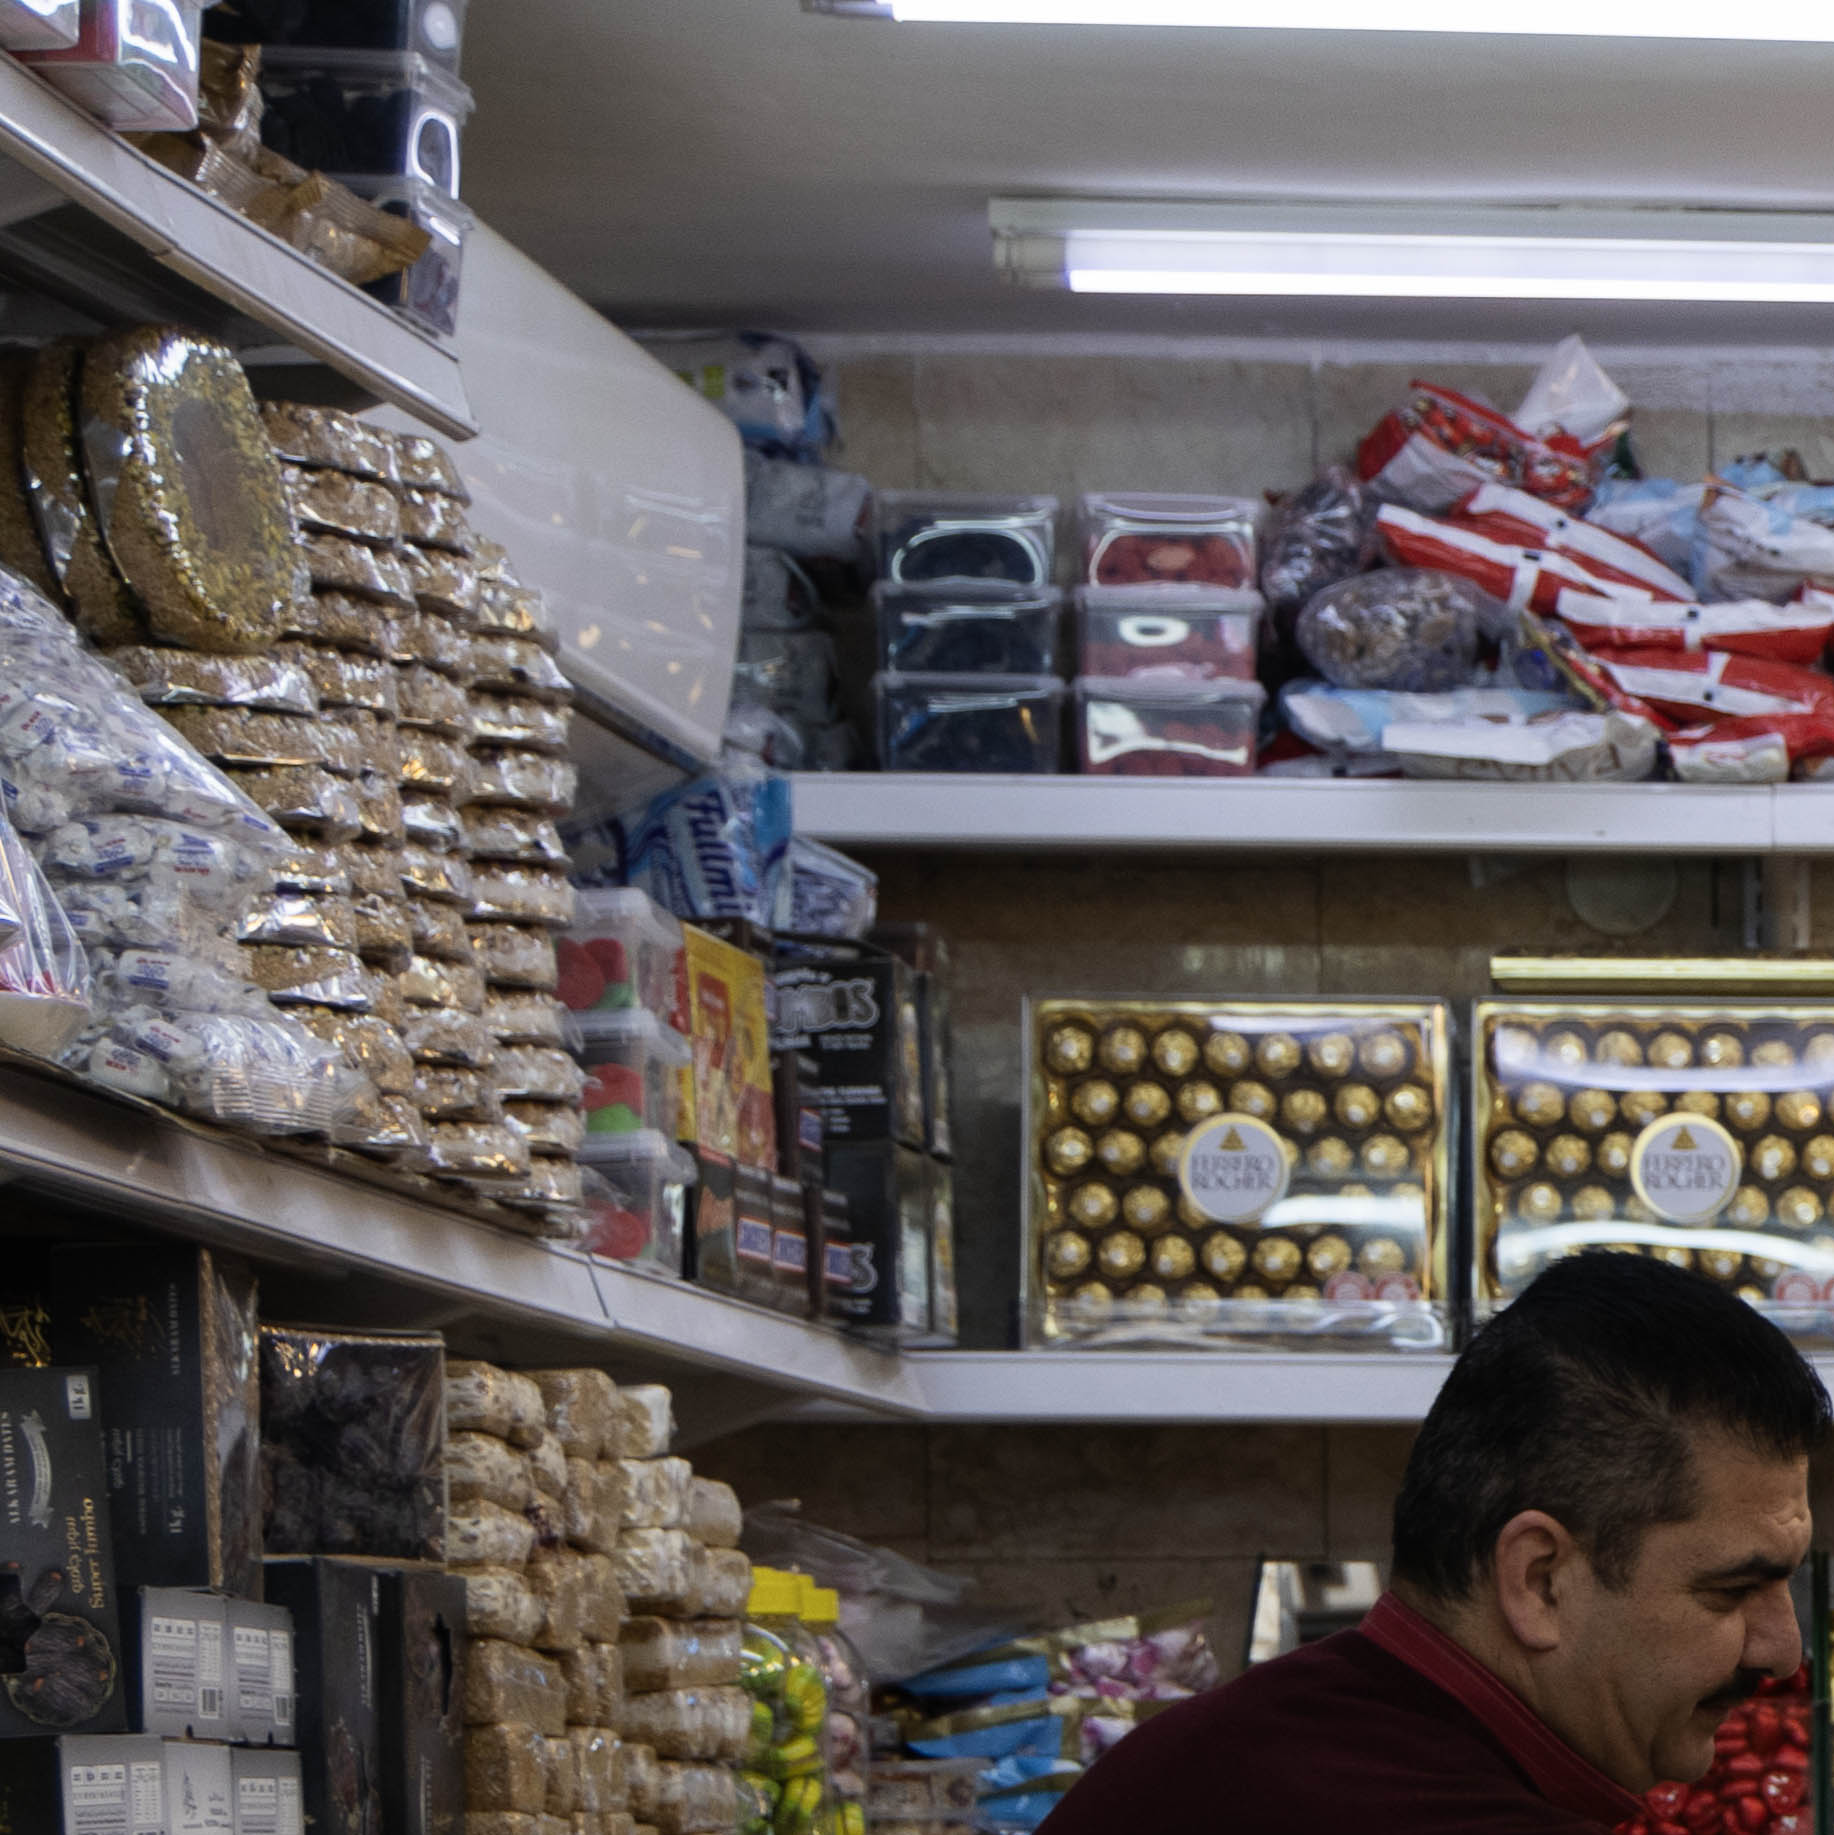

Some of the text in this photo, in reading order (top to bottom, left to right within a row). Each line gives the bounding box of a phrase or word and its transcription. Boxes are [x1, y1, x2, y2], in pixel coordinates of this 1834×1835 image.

[1190, 1155, 1277, 1173] FERRERO
[1639, 1155, 1728, 1173] FERRERO
[1191, 1173, 1277, 1191] ROCHER
[1641, 1173, 1727, 1191] ROCHER
[80, 1497, 106, 1609] Super Jumbo
